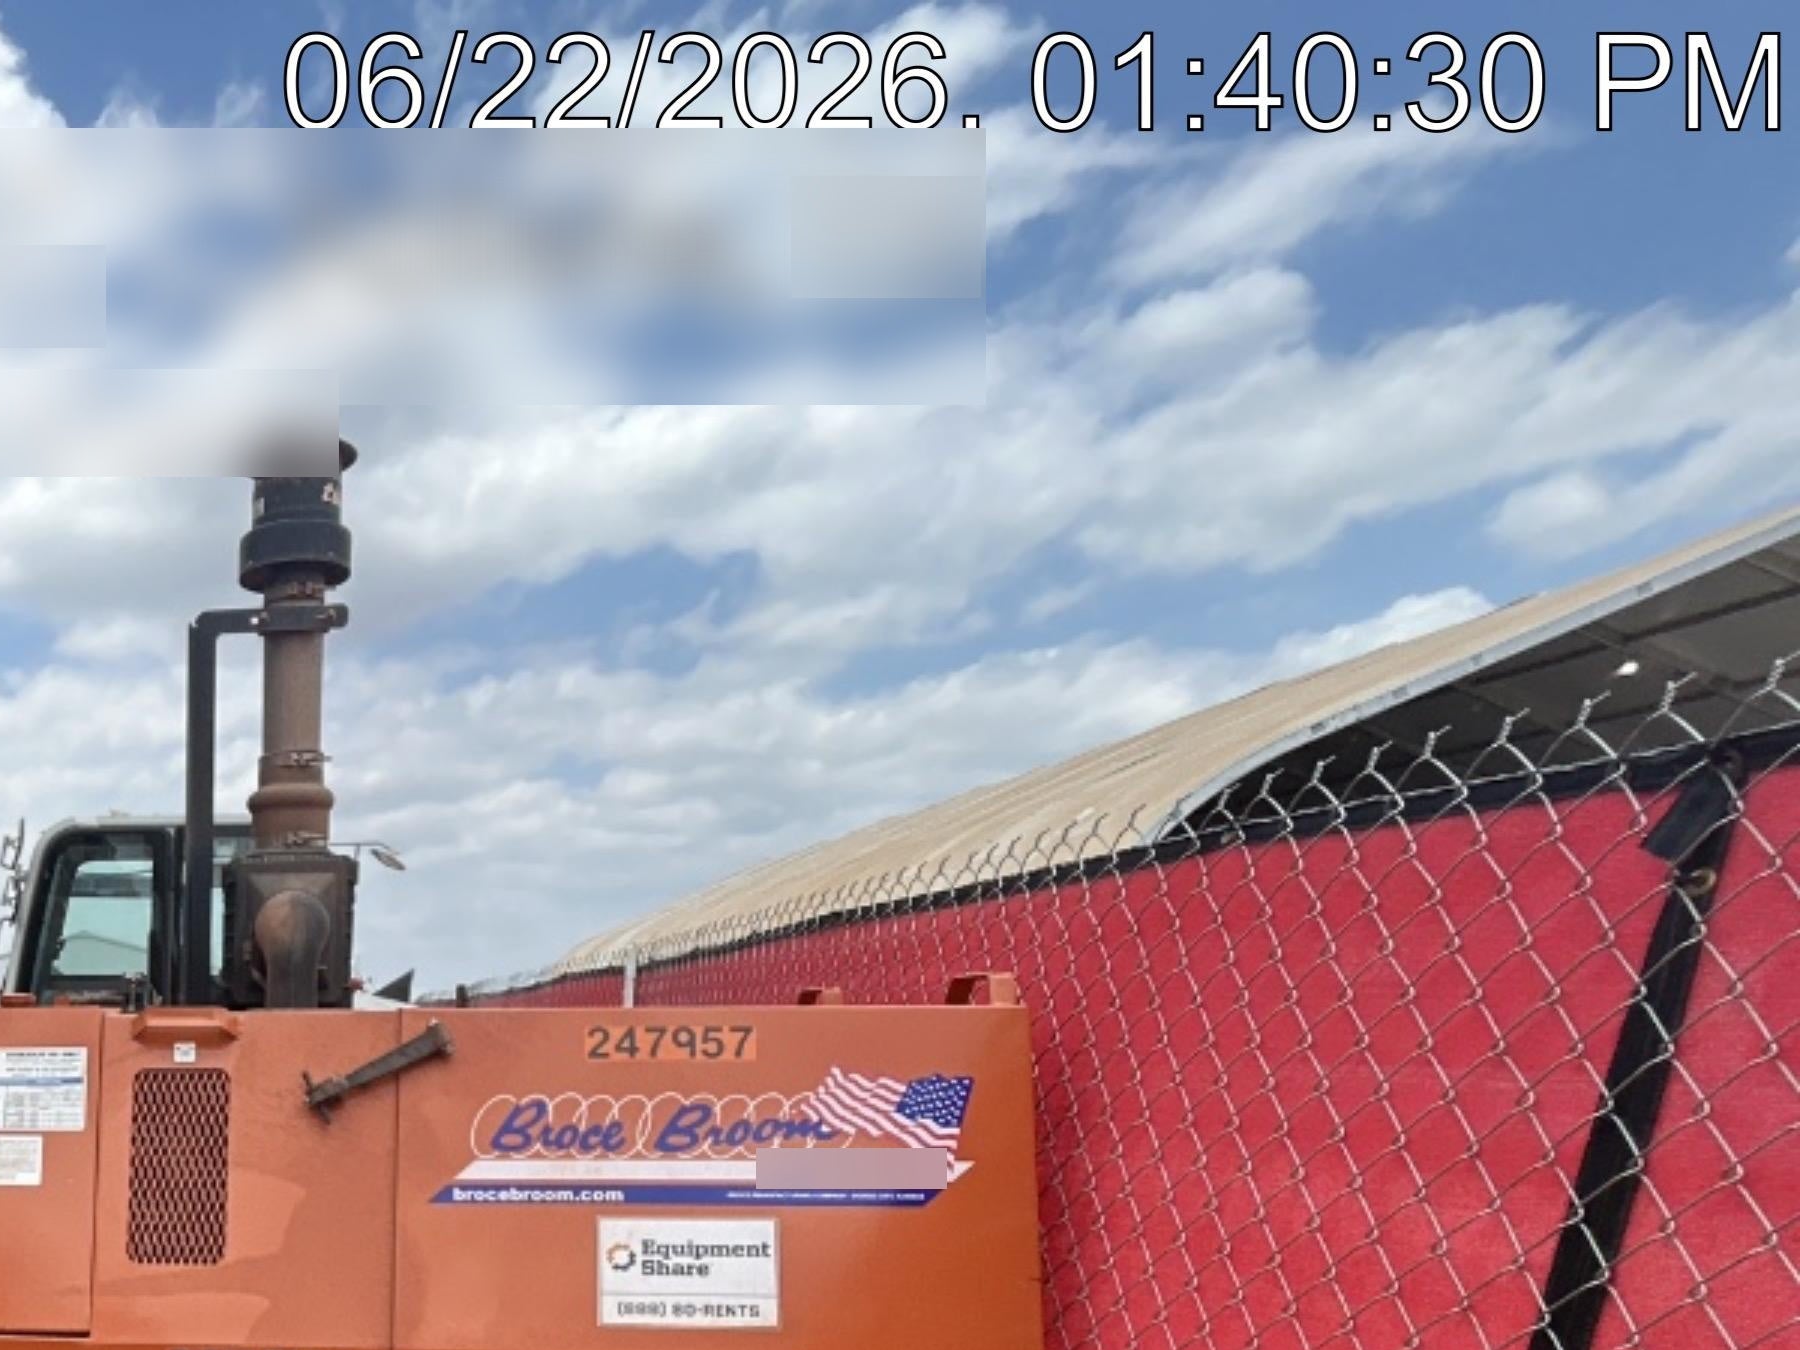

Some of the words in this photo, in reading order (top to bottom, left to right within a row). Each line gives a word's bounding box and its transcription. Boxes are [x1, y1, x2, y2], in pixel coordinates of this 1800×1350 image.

[587, 1026, 754, 1059] 247957
[491, 1099, 626, 1151] Broce
[655, 1103, 838, 1151] Broom
[452, 1187, 625, 1202] brocebroom.com
[640, 1239, 772, 1260] Equipment
[640, 1259, 711, 1277] Share
